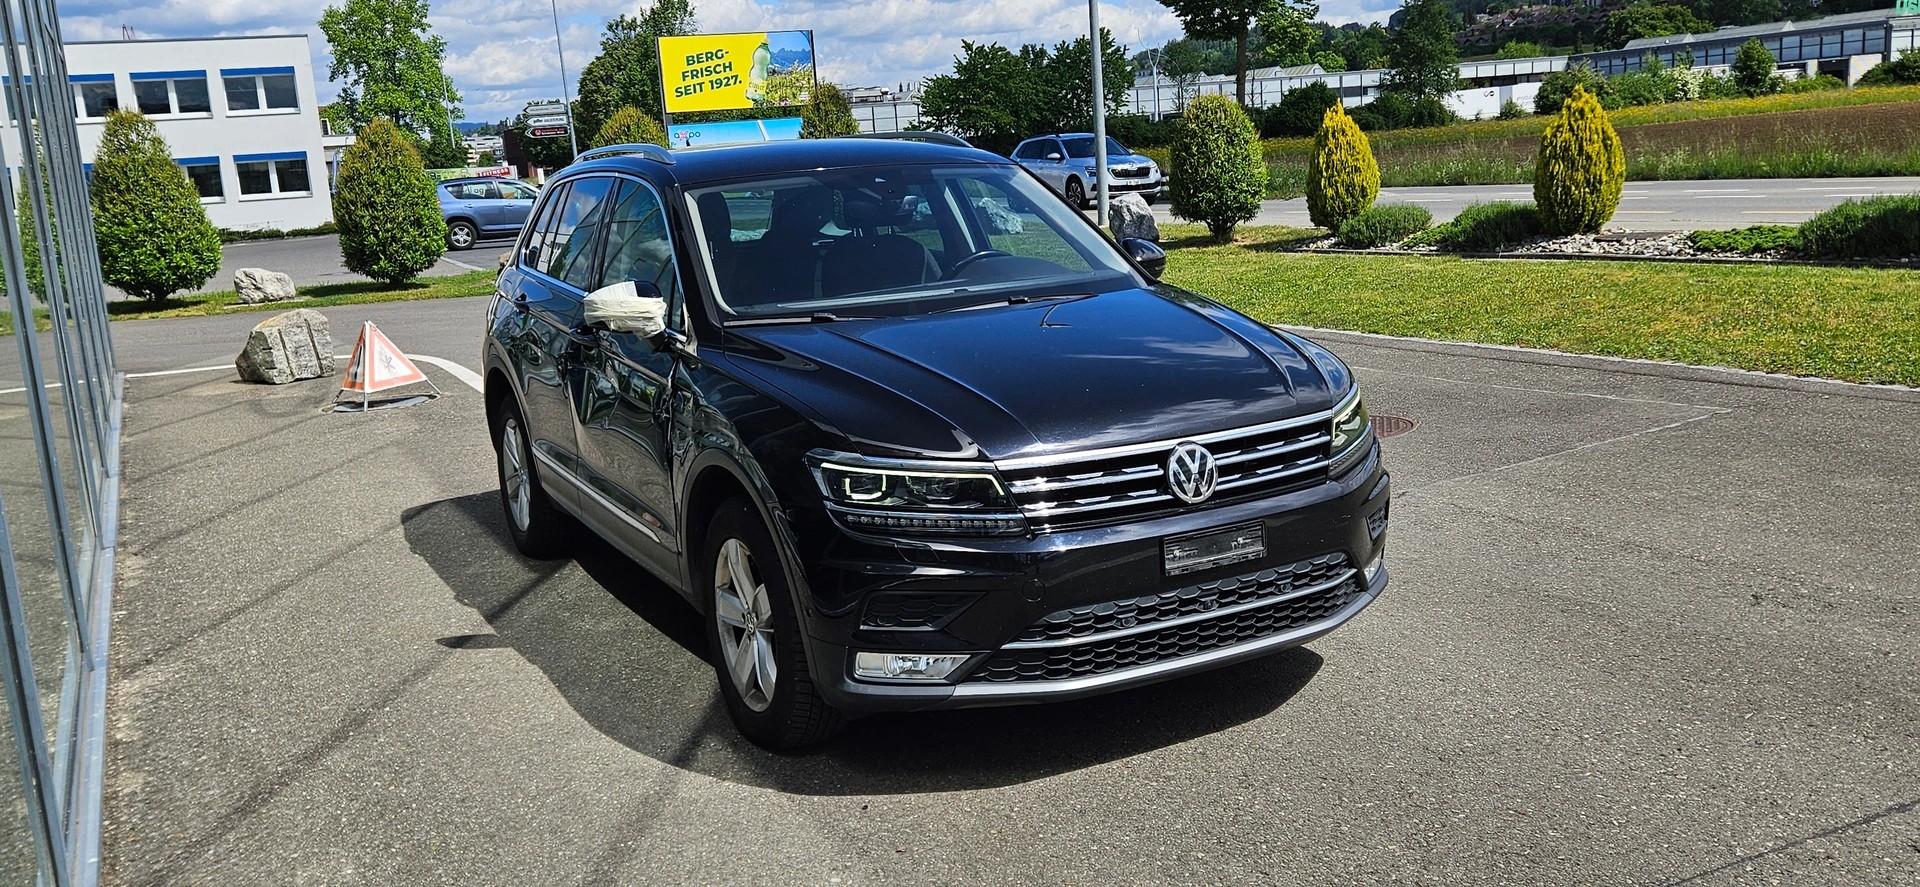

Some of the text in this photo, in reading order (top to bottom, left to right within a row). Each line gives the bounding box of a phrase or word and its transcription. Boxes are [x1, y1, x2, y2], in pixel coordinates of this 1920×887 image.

[686, 48, 729, 66] BERG-
[681, 61, 733, 82] FRISCH
[675, 82, 705, 98] SEIT
[710, 74, 743, 91] 1927.
[673, 130, 701, 142] axpo
